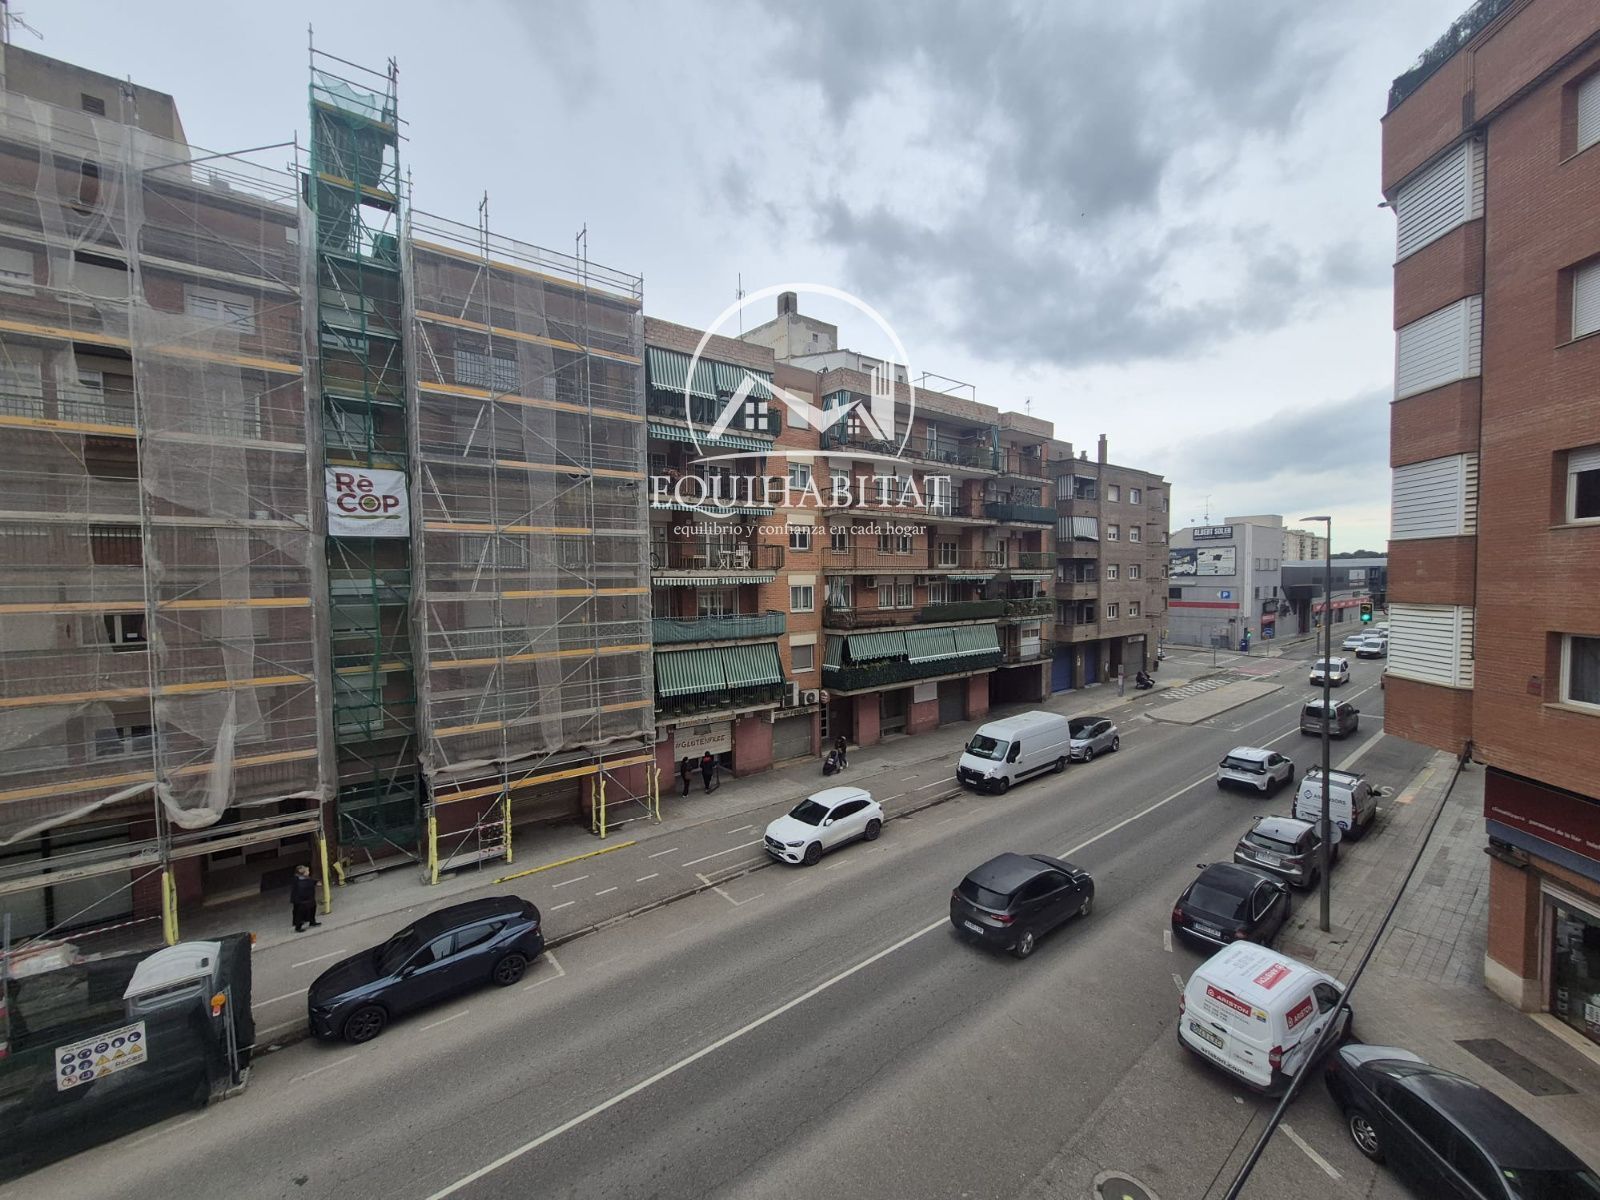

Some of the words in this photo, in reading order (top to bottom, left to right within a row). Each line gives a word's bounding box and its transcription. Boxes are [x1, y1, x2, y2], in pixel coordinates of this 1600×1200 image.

[335, 473, 373, 492] Rè
[337, 493, 399, 512] COP
[1216, 995, 1249, 1015] ARISTON
[1293, 1004, 1313, 1023] ARISTON
